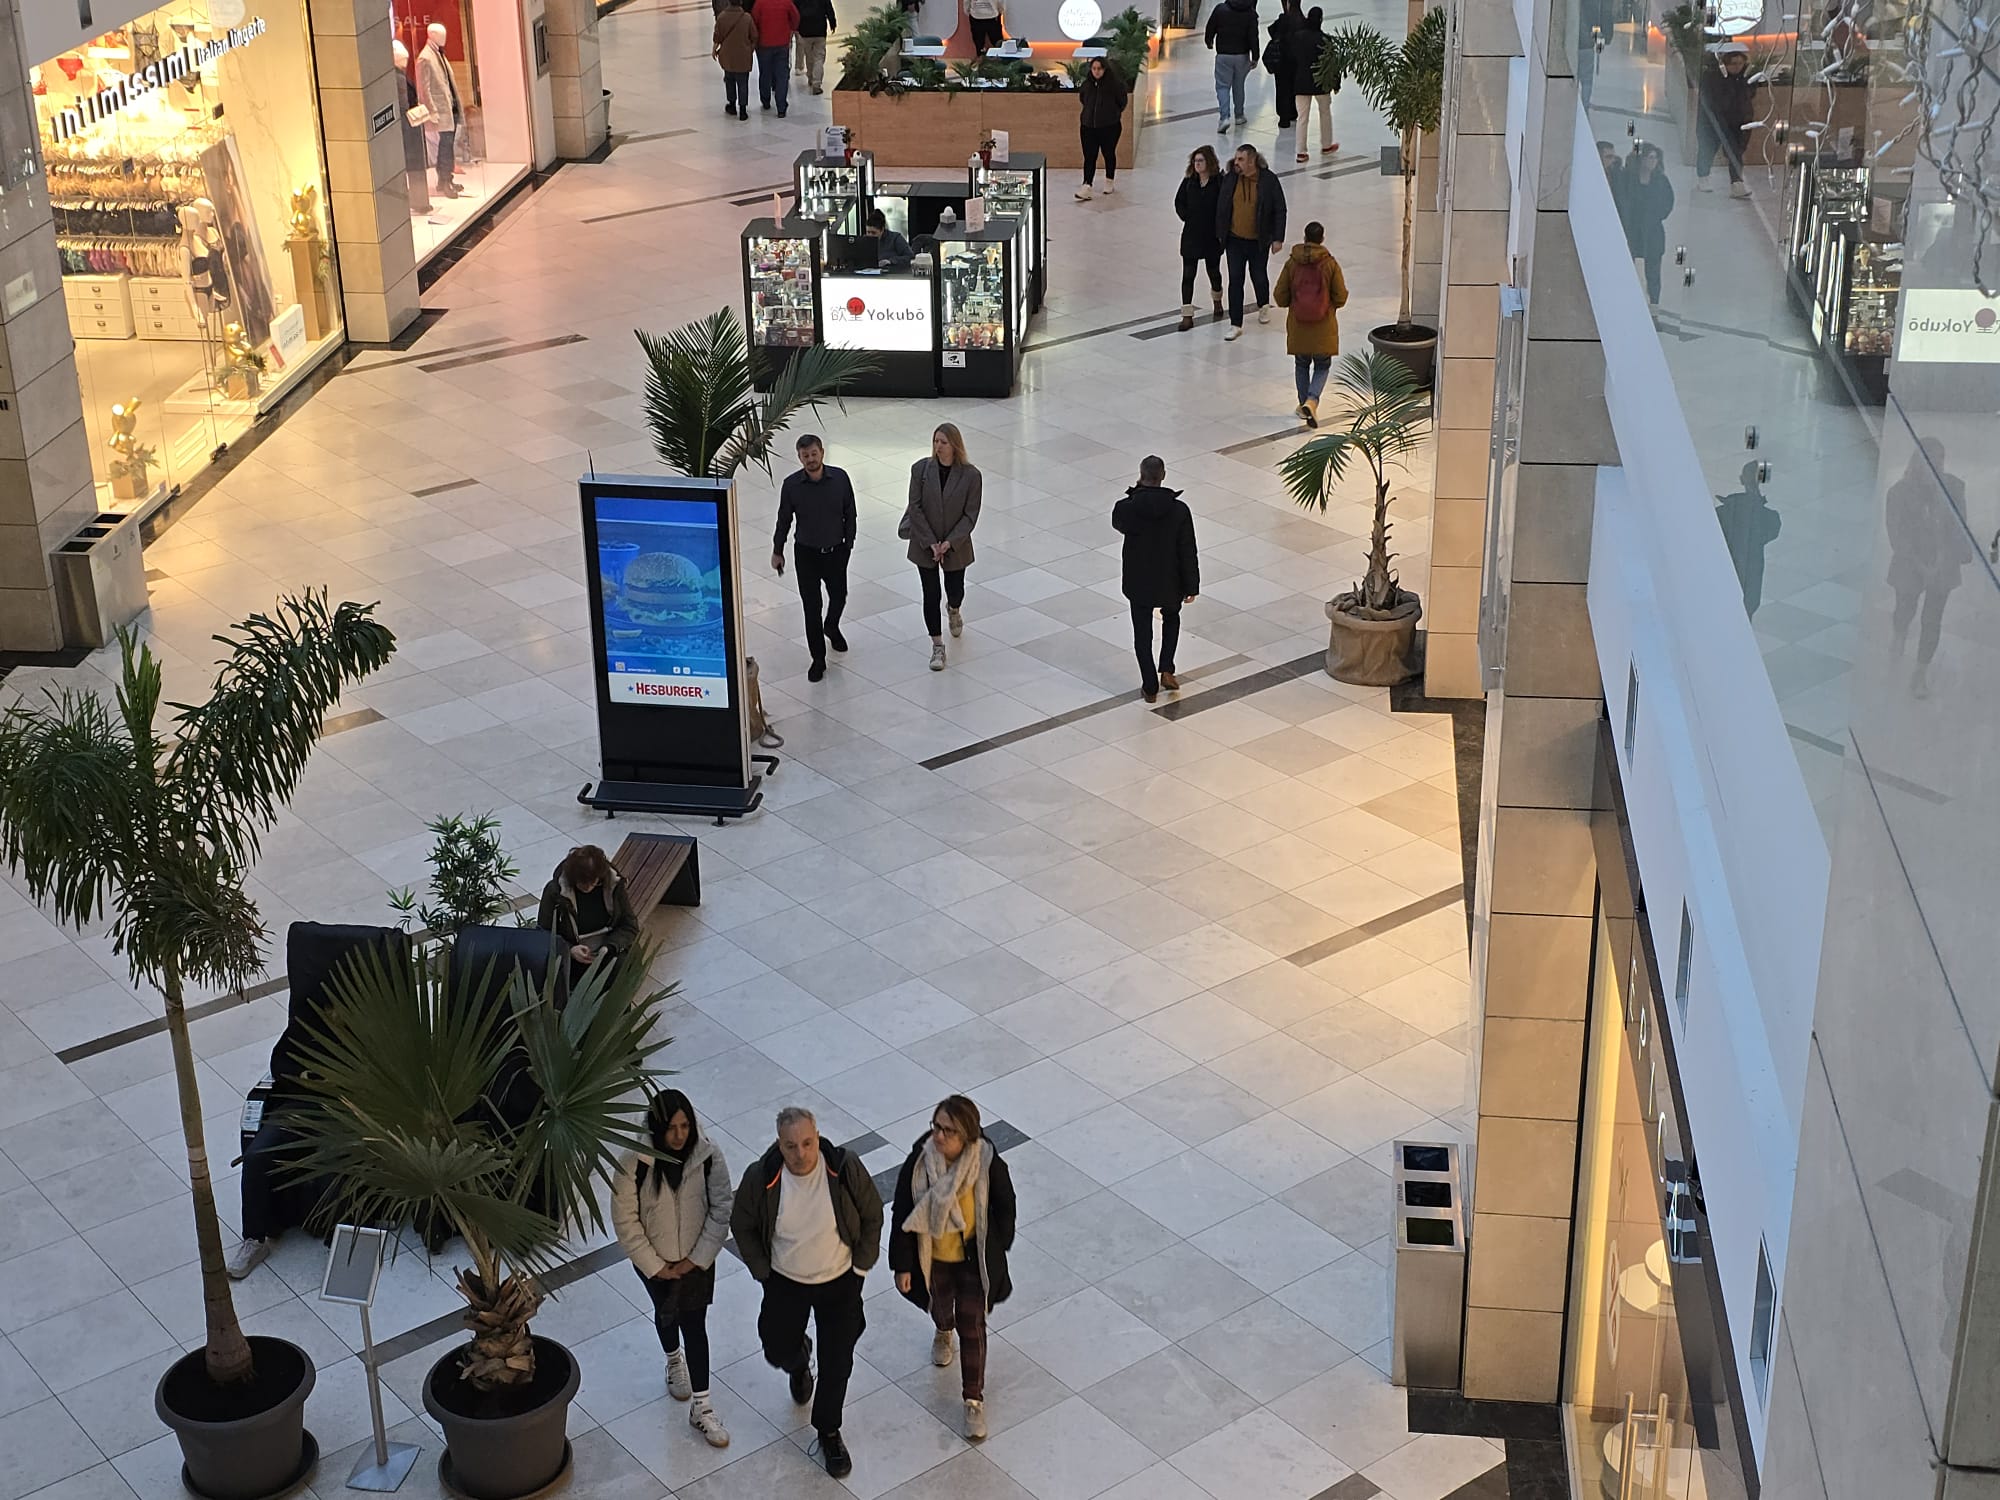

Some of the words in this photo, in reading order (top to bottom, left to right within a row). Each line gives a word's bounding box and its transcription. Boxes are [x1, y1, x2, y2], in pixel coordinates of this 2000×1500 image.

[394, 14, 431, 27] SALE
[228, 16, 266, 49] lingerie
[867, 308, 925, 321] Yokubō
[636, 682, 704, 699] HESBURGER
